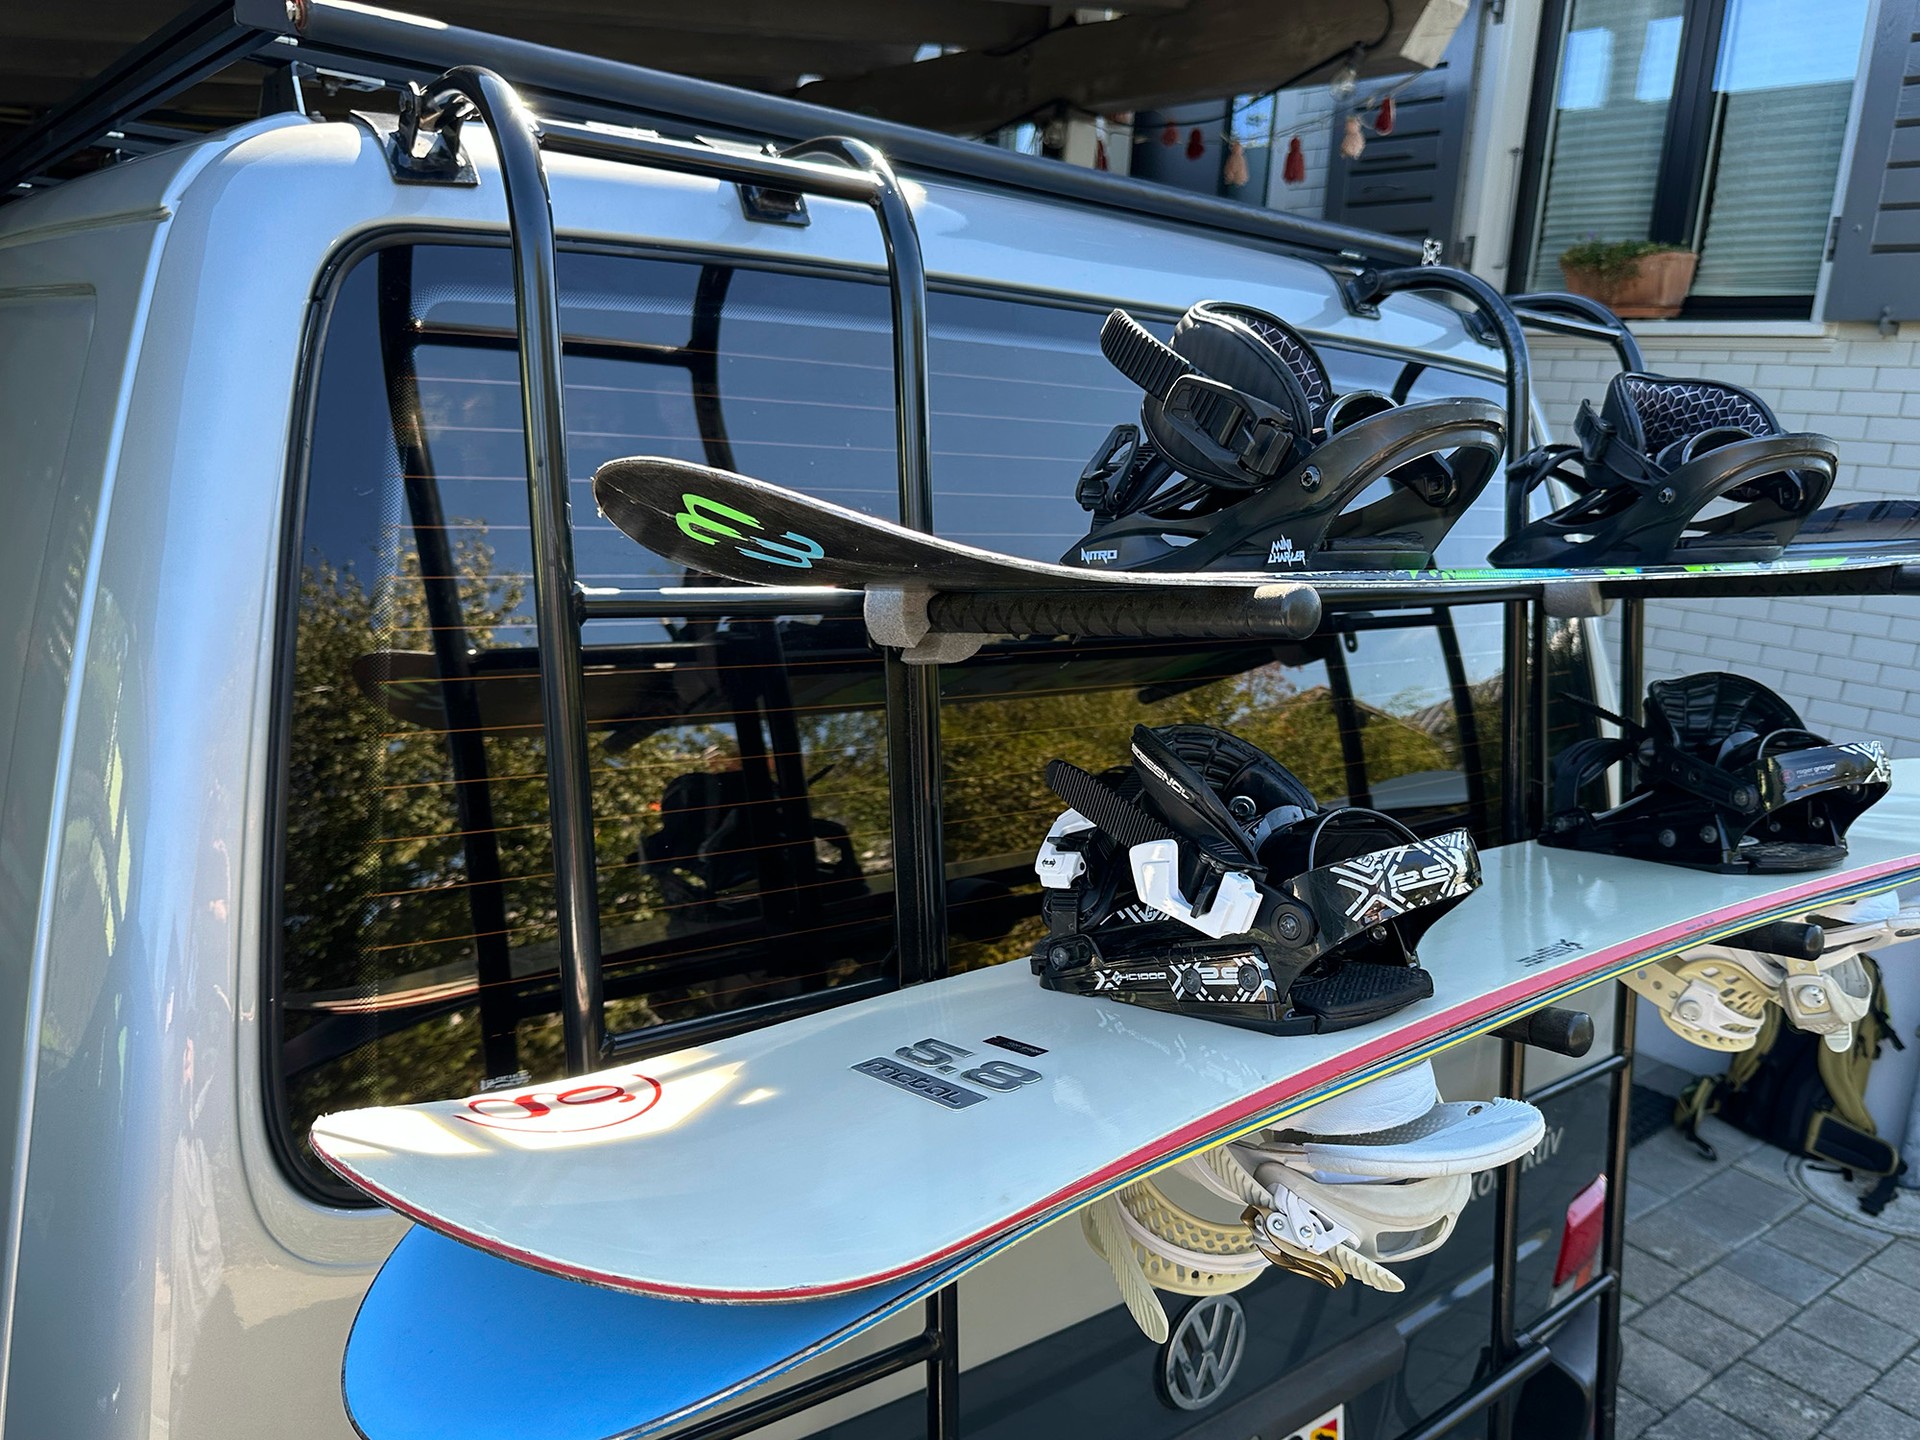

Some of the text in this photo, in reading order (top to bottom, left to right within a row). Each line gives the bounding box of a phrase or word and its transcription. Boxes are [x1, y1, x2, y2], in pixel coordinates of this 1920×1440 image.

[1081, 547, 1117, 564] NITRO
[1271, 534, 1293, 554] MINI
[895, 1037, 1043, 1093] 5.8
[1166, 1295, 1246, 1411] VW
